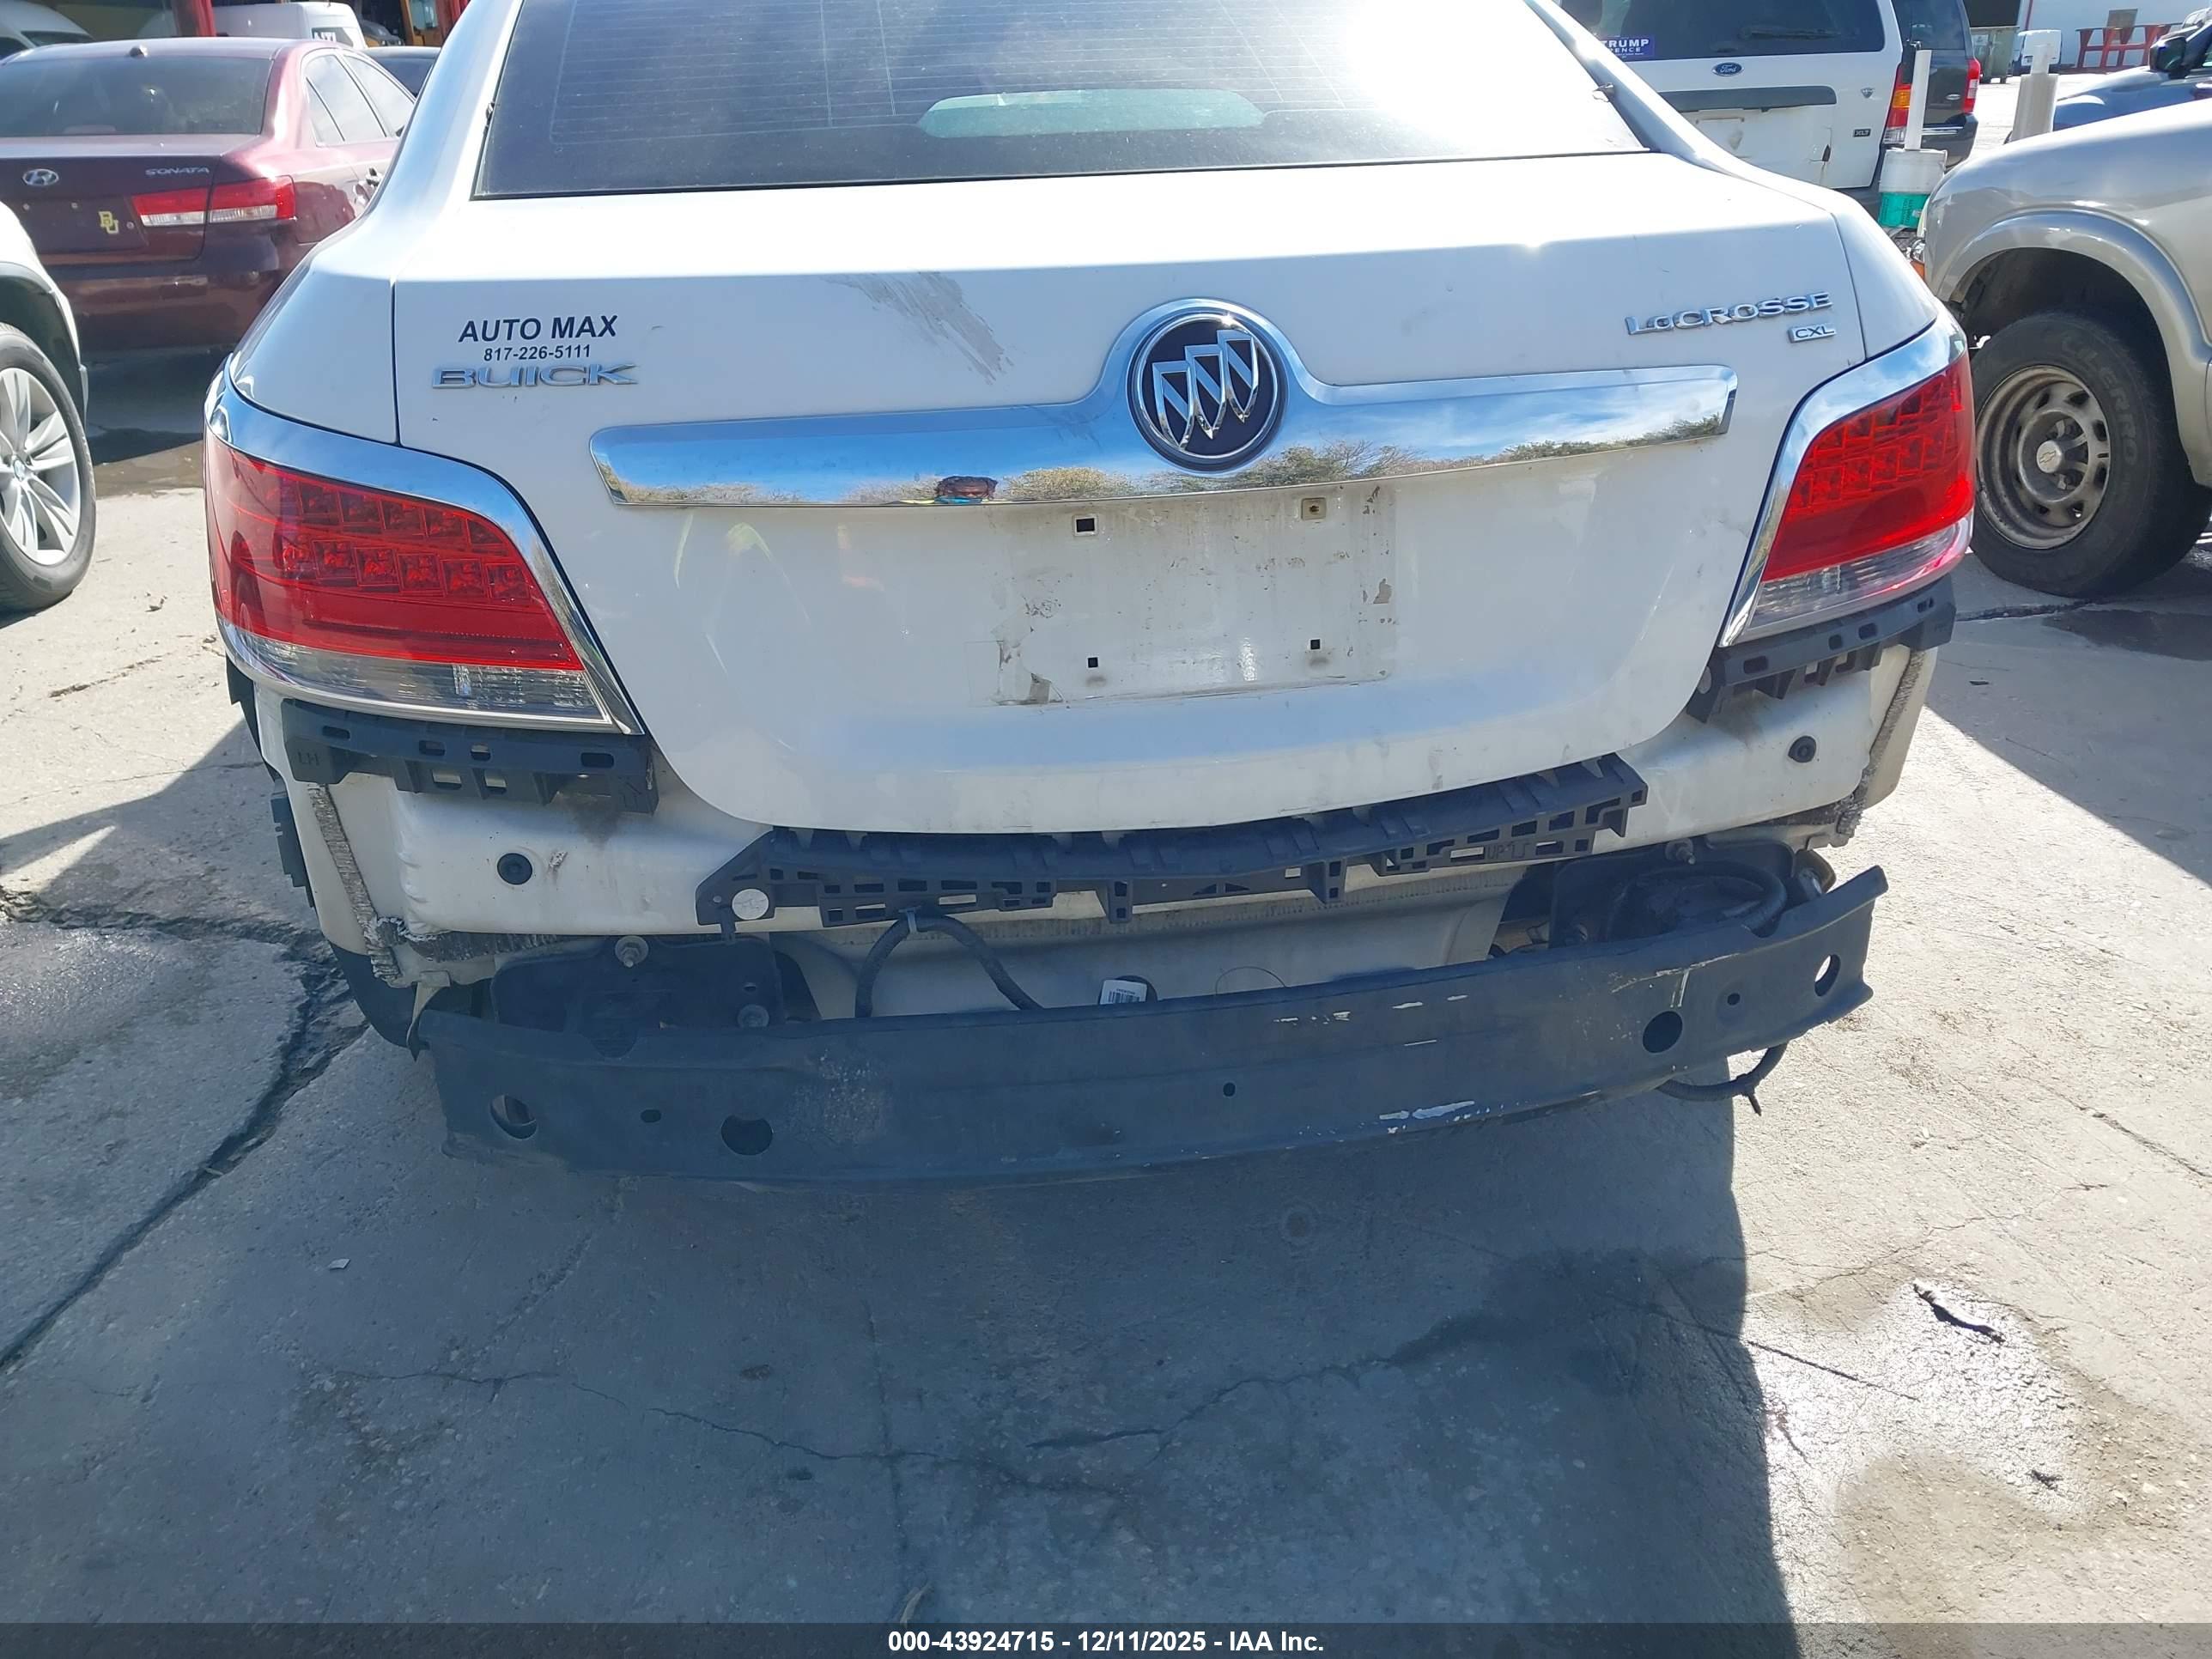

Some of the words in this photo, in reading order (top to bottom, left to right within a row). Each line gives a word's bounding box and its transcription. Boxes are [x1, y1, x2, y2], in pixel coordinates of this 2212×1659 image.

[145, 167, 210, 176] SONATA
[458, 318, 542, 343] AUTO
[550, 314, 618, 339] MAX
[1795, 325, 1835, 339] CXL
[483, 343, 591, 362] 817-226-5111
[432, 363, 640, 390] BUICK
